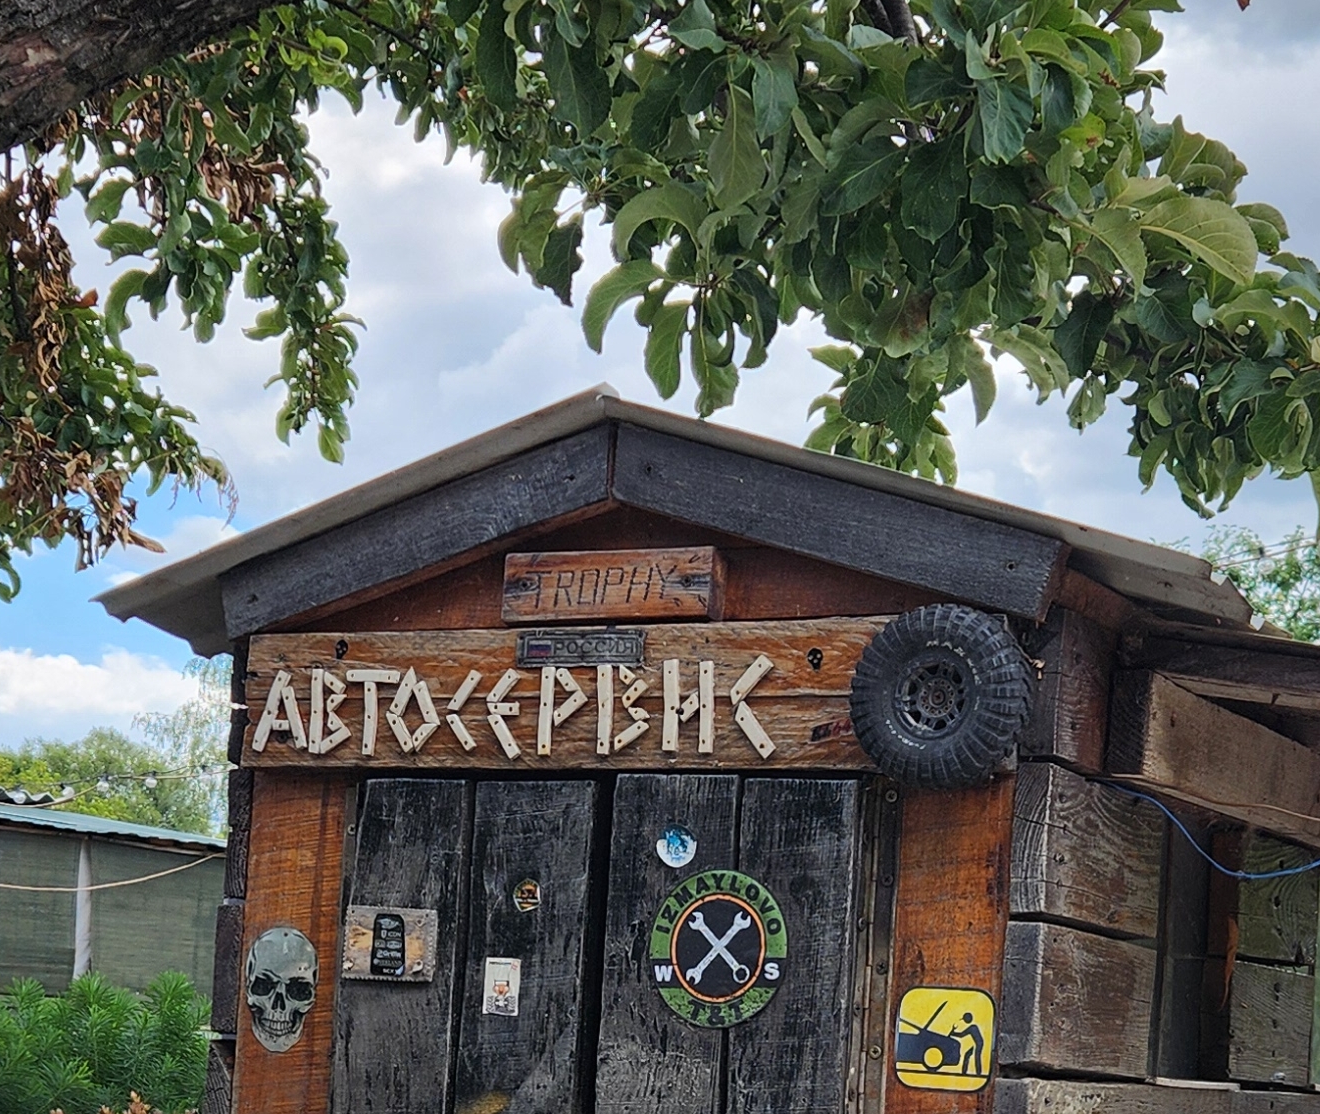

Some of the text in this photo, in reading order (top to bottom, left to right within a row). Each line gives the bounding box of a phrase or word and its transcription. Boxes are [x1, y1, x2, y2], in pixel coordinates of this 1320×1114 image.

[525, 562, 678, 609] TROPHY
[553, 639, 638, 656] РОССИЯ
[251, 653, 776, 761] АВТОСЕРВИС
[655, 872, 781, 936] IZMAYLOVO
[654, 961, 781, 983] W S
[687, 997, 745, 1026] T&T
